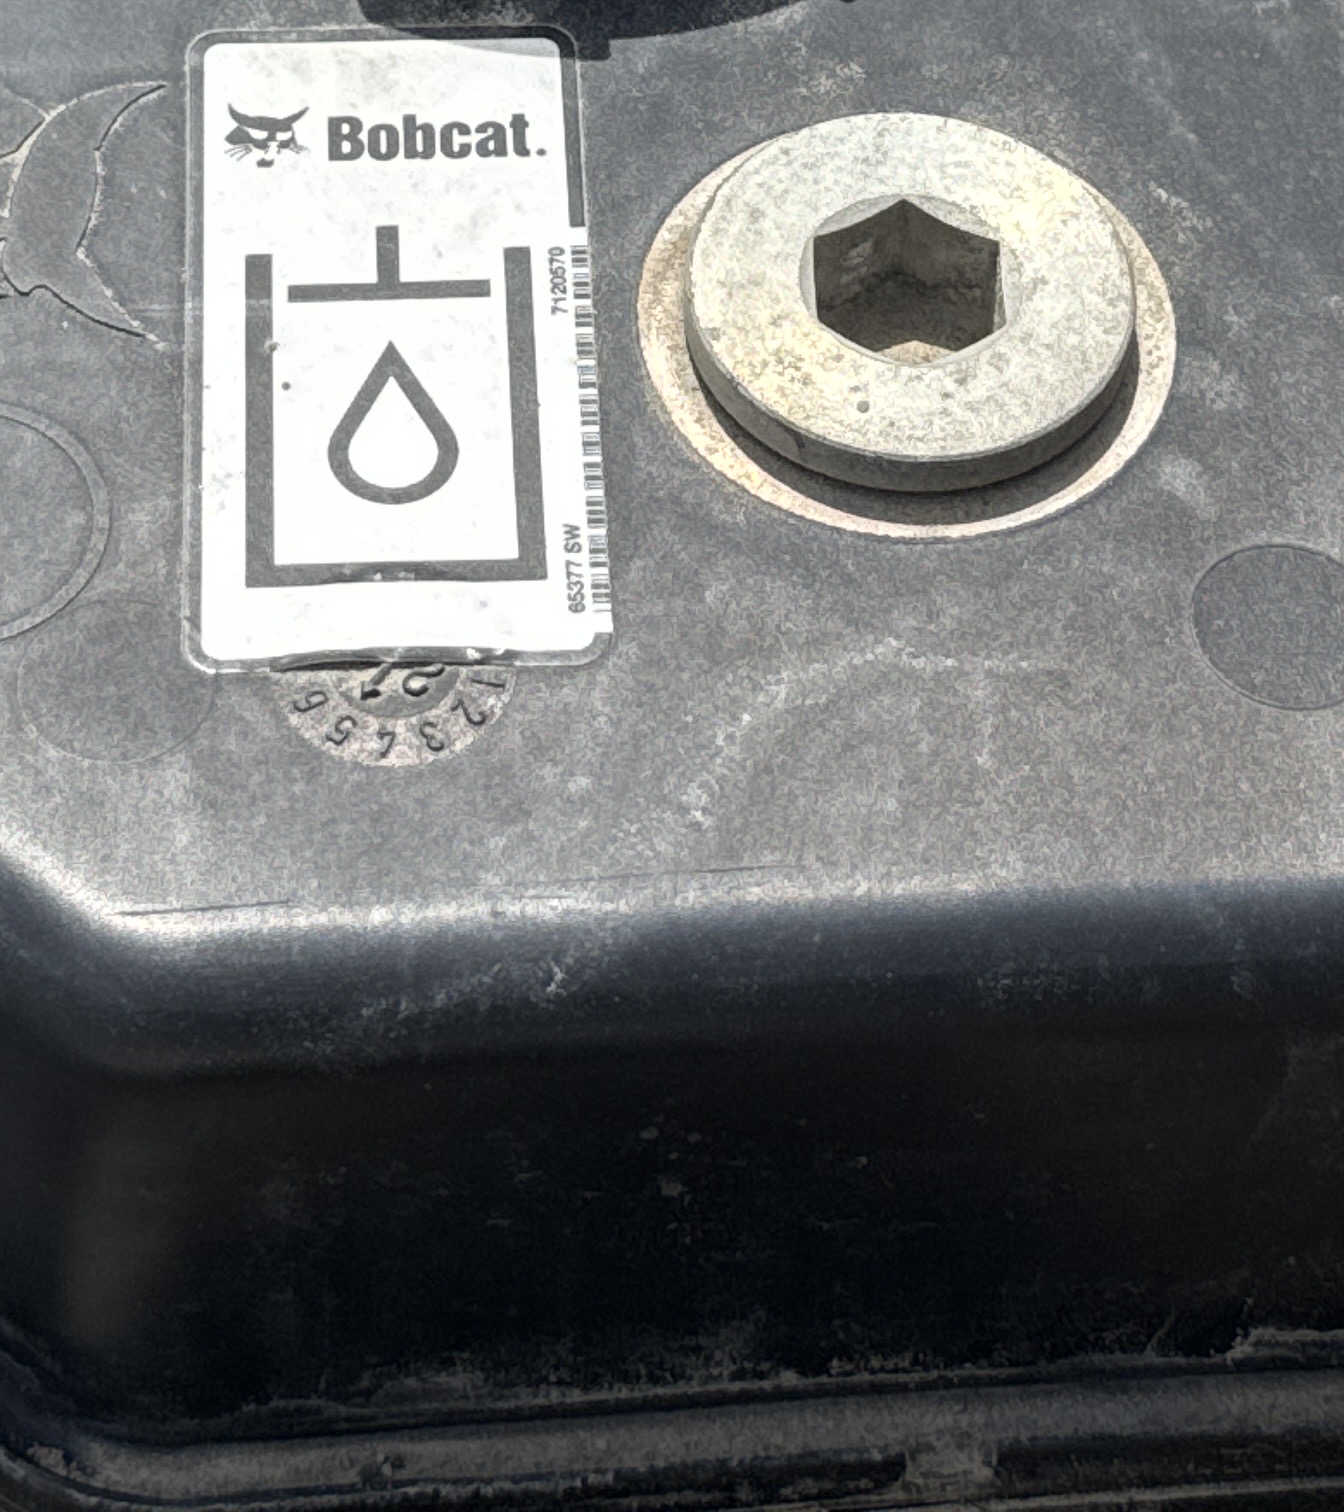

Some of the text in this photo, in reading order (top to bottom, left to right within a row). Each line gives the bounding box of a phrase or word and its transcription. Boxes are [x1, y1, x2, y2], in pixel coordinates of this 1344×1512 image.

[548, 246, 568, 316] 7120570
[563, 524, 586, 614] 65377 SW
